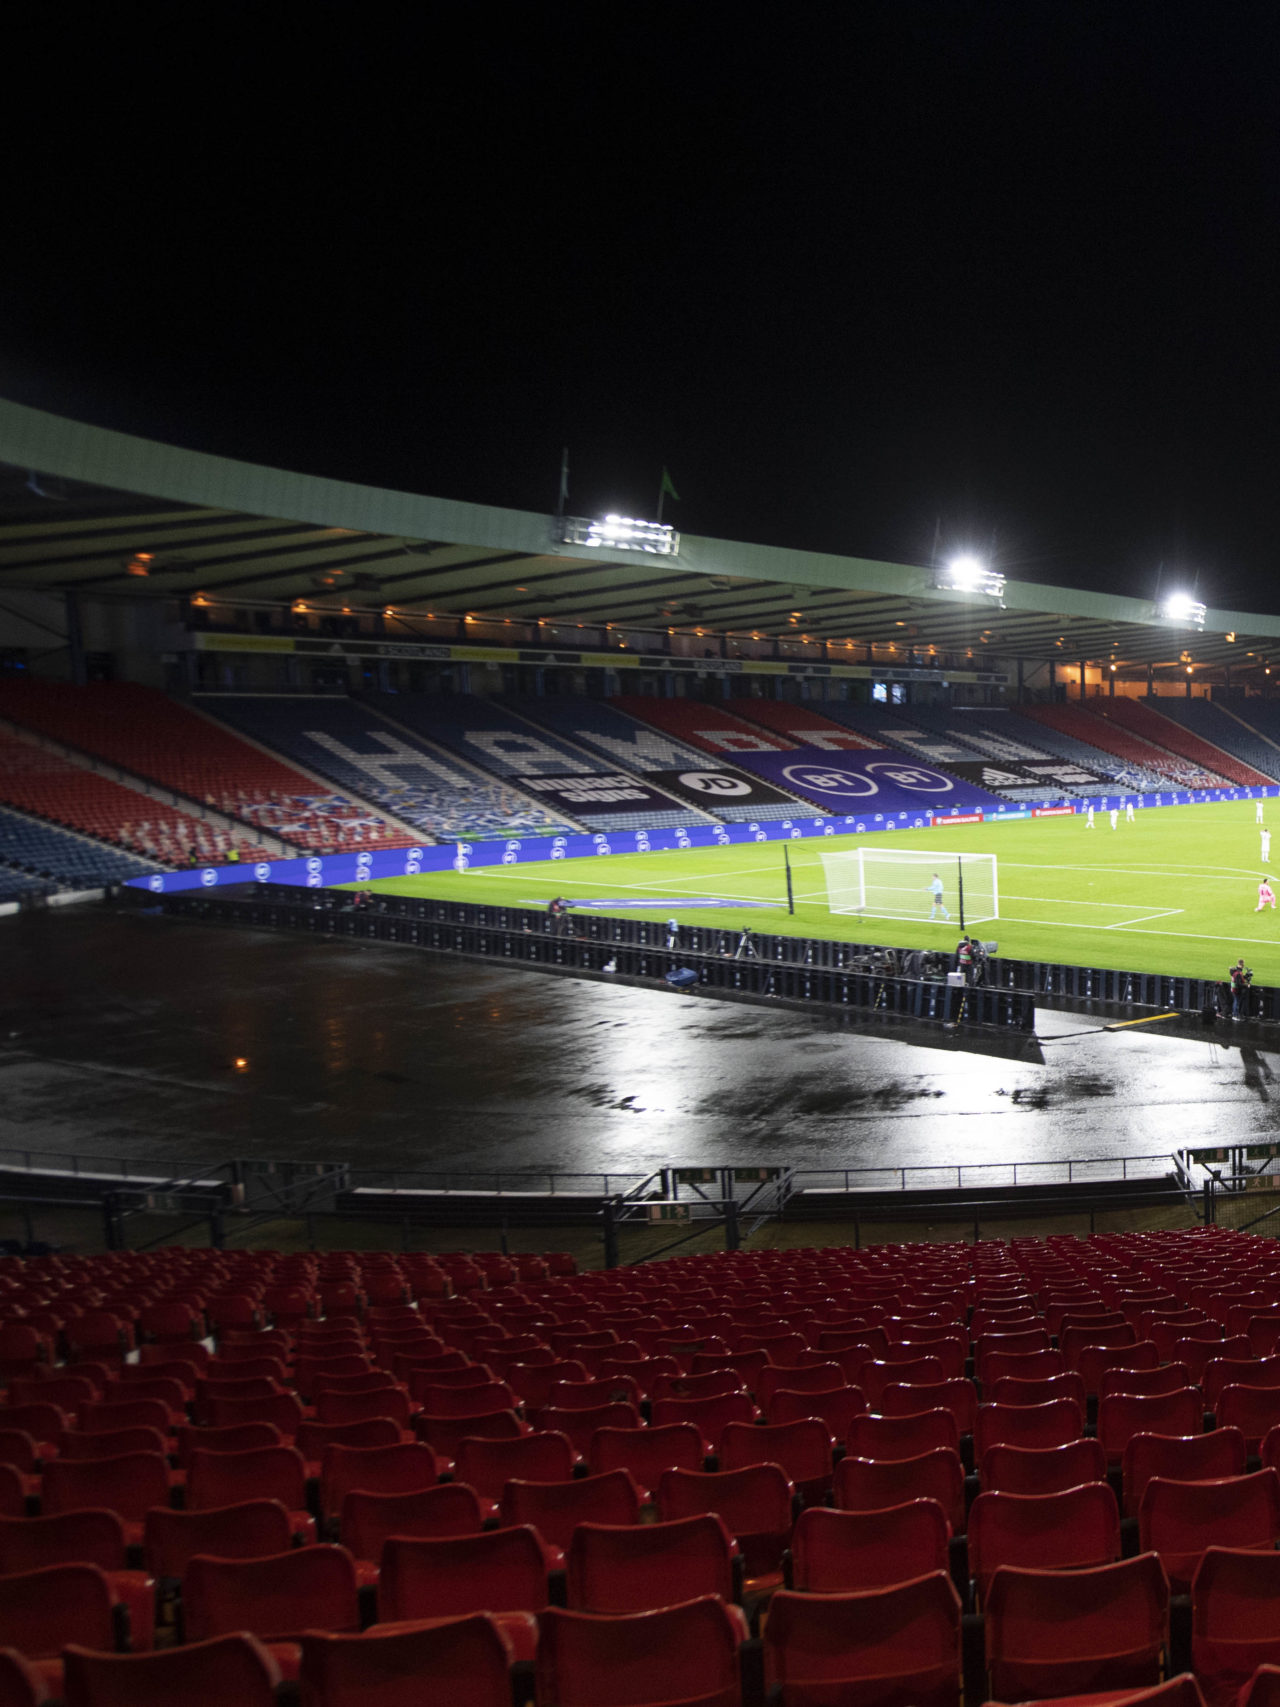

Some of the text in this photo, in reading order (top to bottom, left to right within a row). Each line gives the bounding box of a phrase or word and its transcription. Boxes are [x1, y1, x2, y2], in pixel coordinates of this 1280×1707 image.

[699, 777, 740, 791] JD
[802, 773, 855, 787] BT
[883, 771, 933, 784] BT
